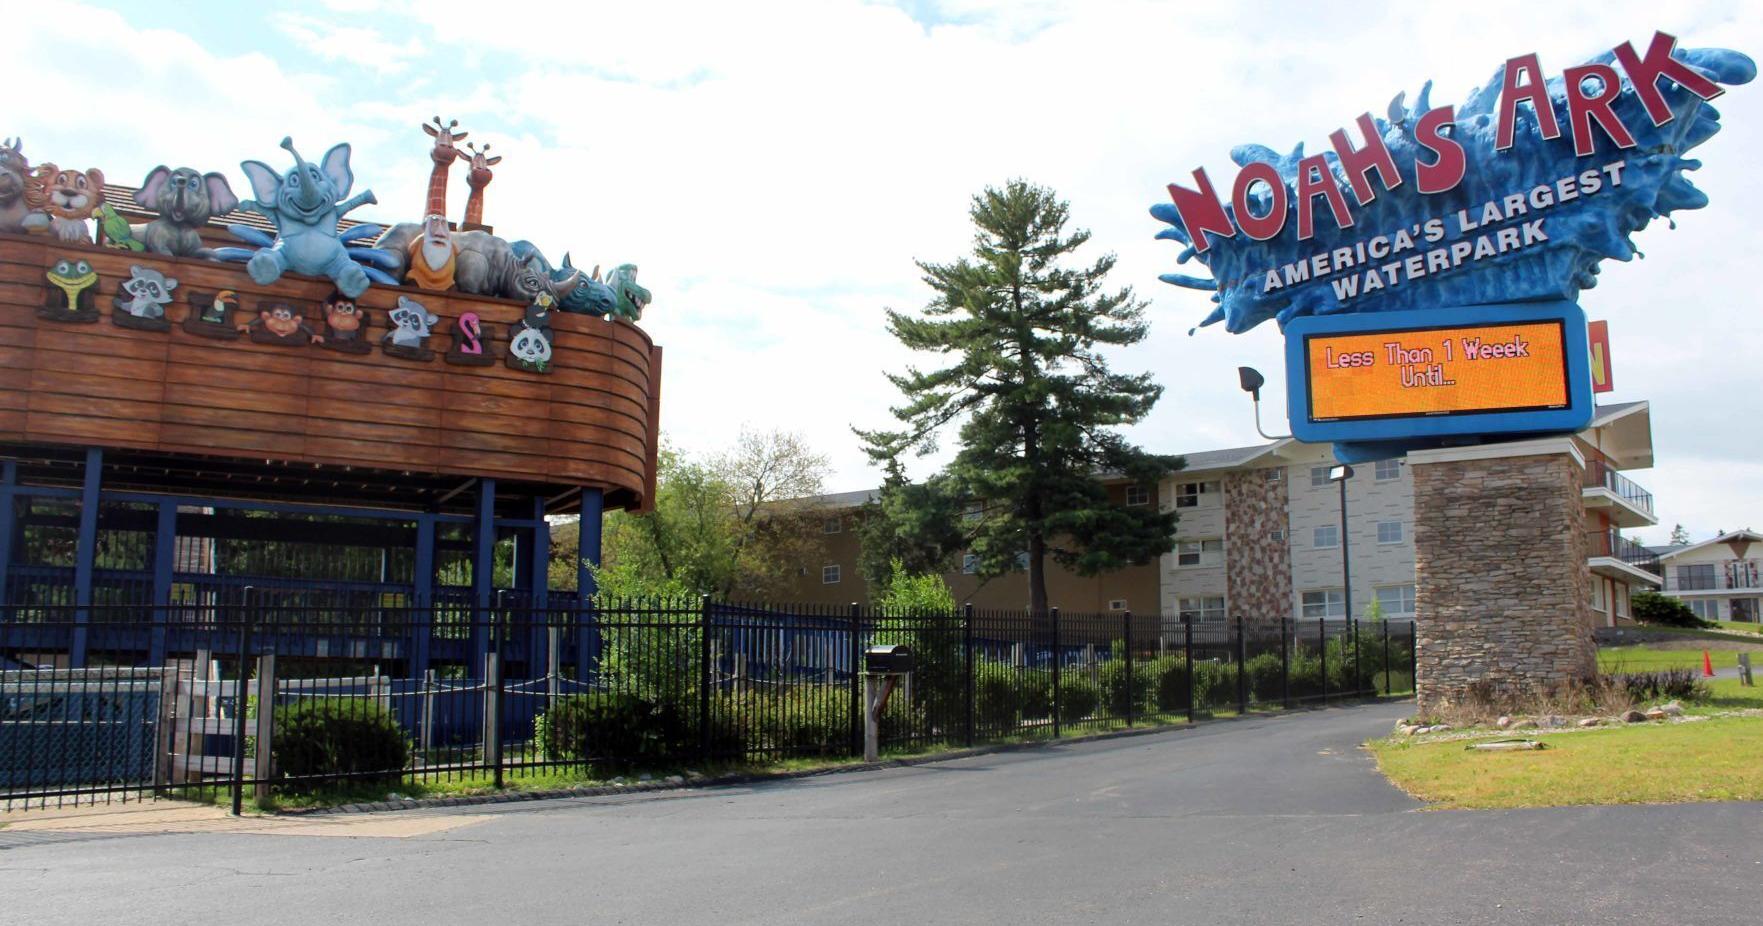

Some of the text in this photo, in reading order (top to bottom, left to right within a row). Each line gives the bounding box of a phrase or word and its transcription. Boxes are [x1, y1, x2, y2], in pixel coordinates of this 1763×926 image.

[1495, 30, 1726, 157] ARK
[1263, 160, 1627, 293] AMERICA'S LARGEST
[1332, 218, 1549, 301] WATERPARK
[1326, 335, 1530, 369] Less Than 1 Weeek
[1400, 364, 1456, 388] Until...
